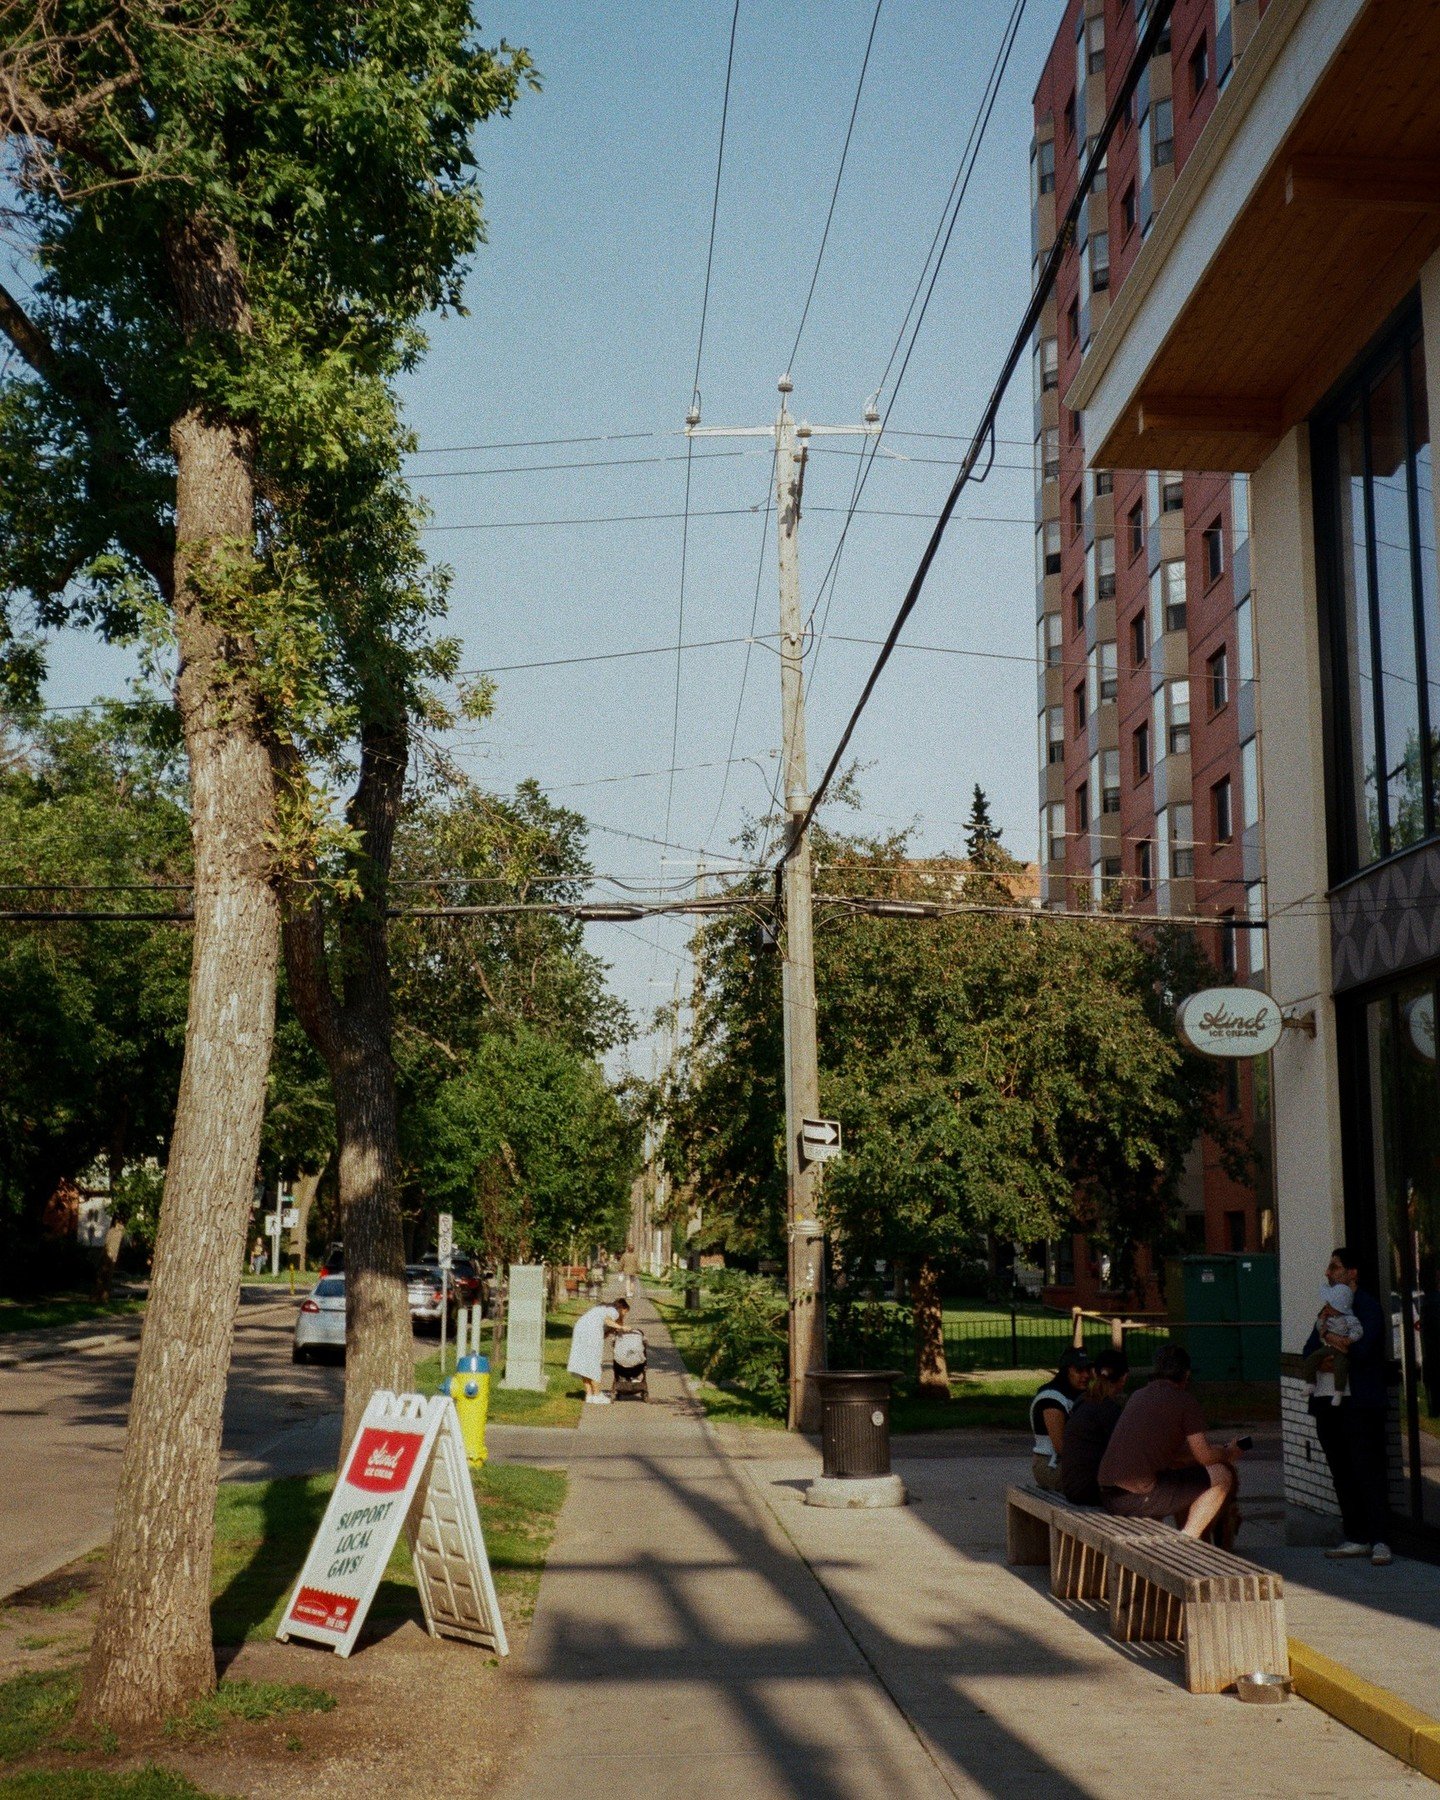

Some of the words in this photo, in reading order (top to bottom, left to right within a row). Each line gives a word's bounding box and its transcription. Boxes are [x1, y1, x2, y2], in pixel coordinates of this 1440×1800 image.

[1199, 1002, 1268, 1030] Kind
[1225, 1030, 1259, 1038] CREAM
[336, 1501, 393, 1530] SUPPORT
[335, 1529, 373, 1554] LOCAL
[327, 1554, 364, 1577] GAYS!
